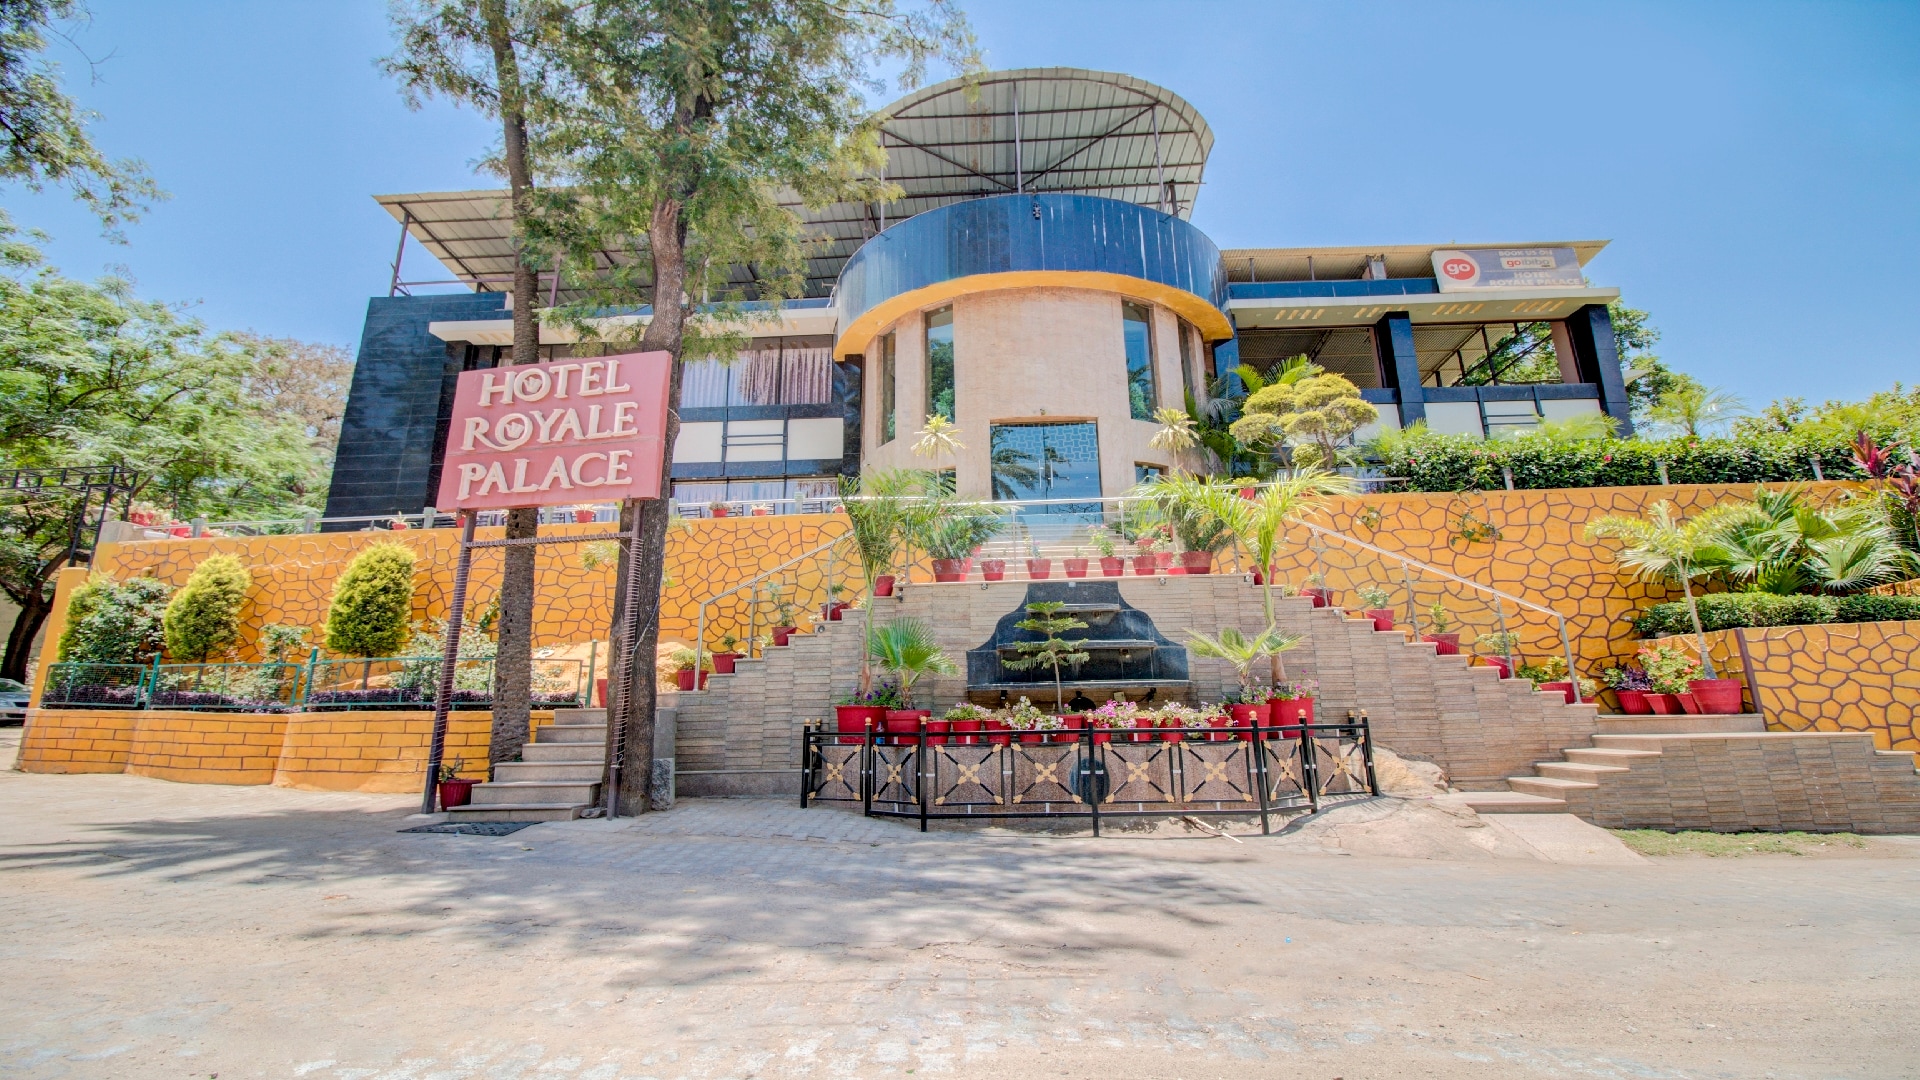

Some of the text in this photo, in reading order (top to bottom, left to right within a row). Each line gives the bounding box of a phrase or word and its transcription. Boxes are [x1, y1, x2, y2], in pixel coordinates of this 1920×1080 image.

[1506, 257, 1550, 267] goibibo
[1446, 263, 1471, 275] go
[1513, 271, 1551, 279] HOTEL
[1489, 278, 1534, 286] ROYALE
[478, 360, 630, 407] HOTEL
[460, 401, 638, 451] ROYALE
[456, 450, 632, 500] PALACE
